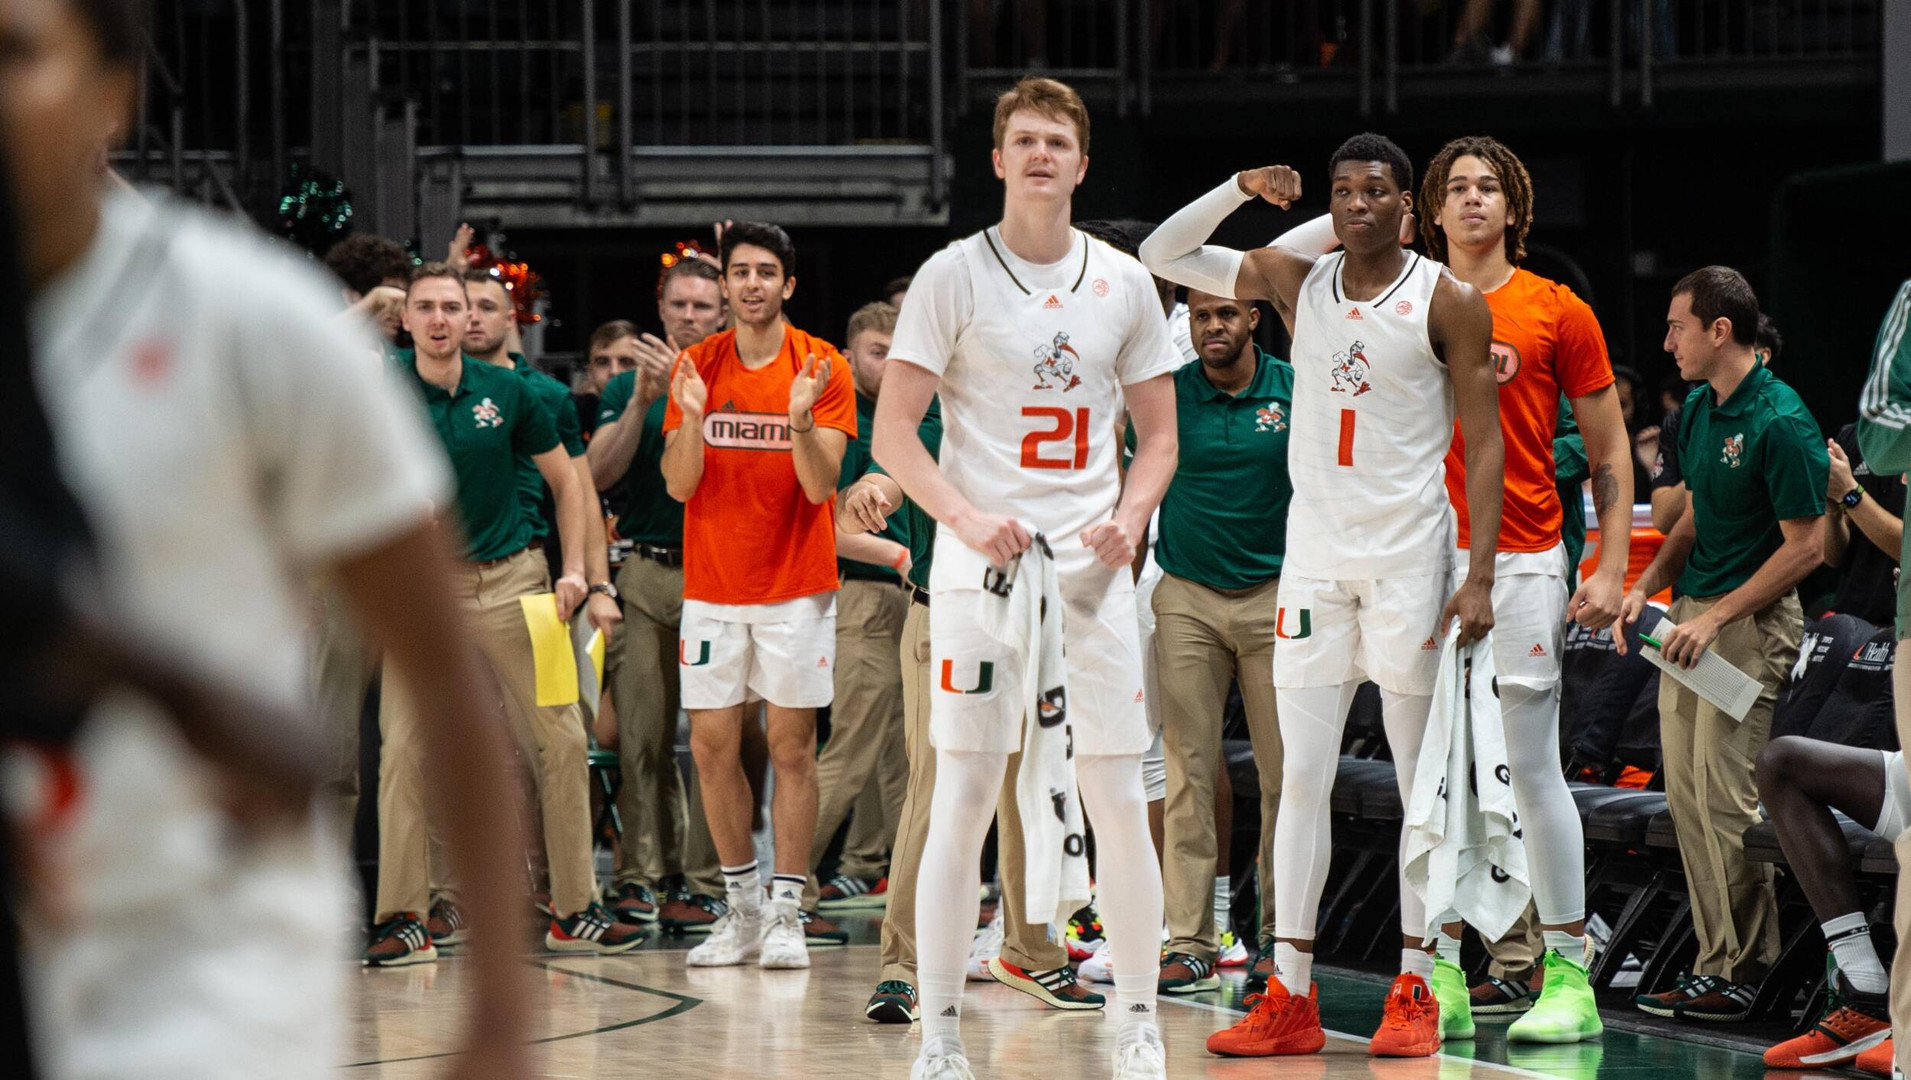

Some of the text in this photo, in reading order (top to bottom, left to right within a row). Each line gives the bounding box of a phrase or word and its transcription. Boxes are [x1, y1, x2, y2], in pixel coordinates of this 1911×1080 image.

[1020, 406, 1091, 470] 21
[1338, 408, 1356, 467] 1
[1276, 607, 1312, 639] U
[680, 638, 711, 666] U
[940, 659, 994, 694] U
